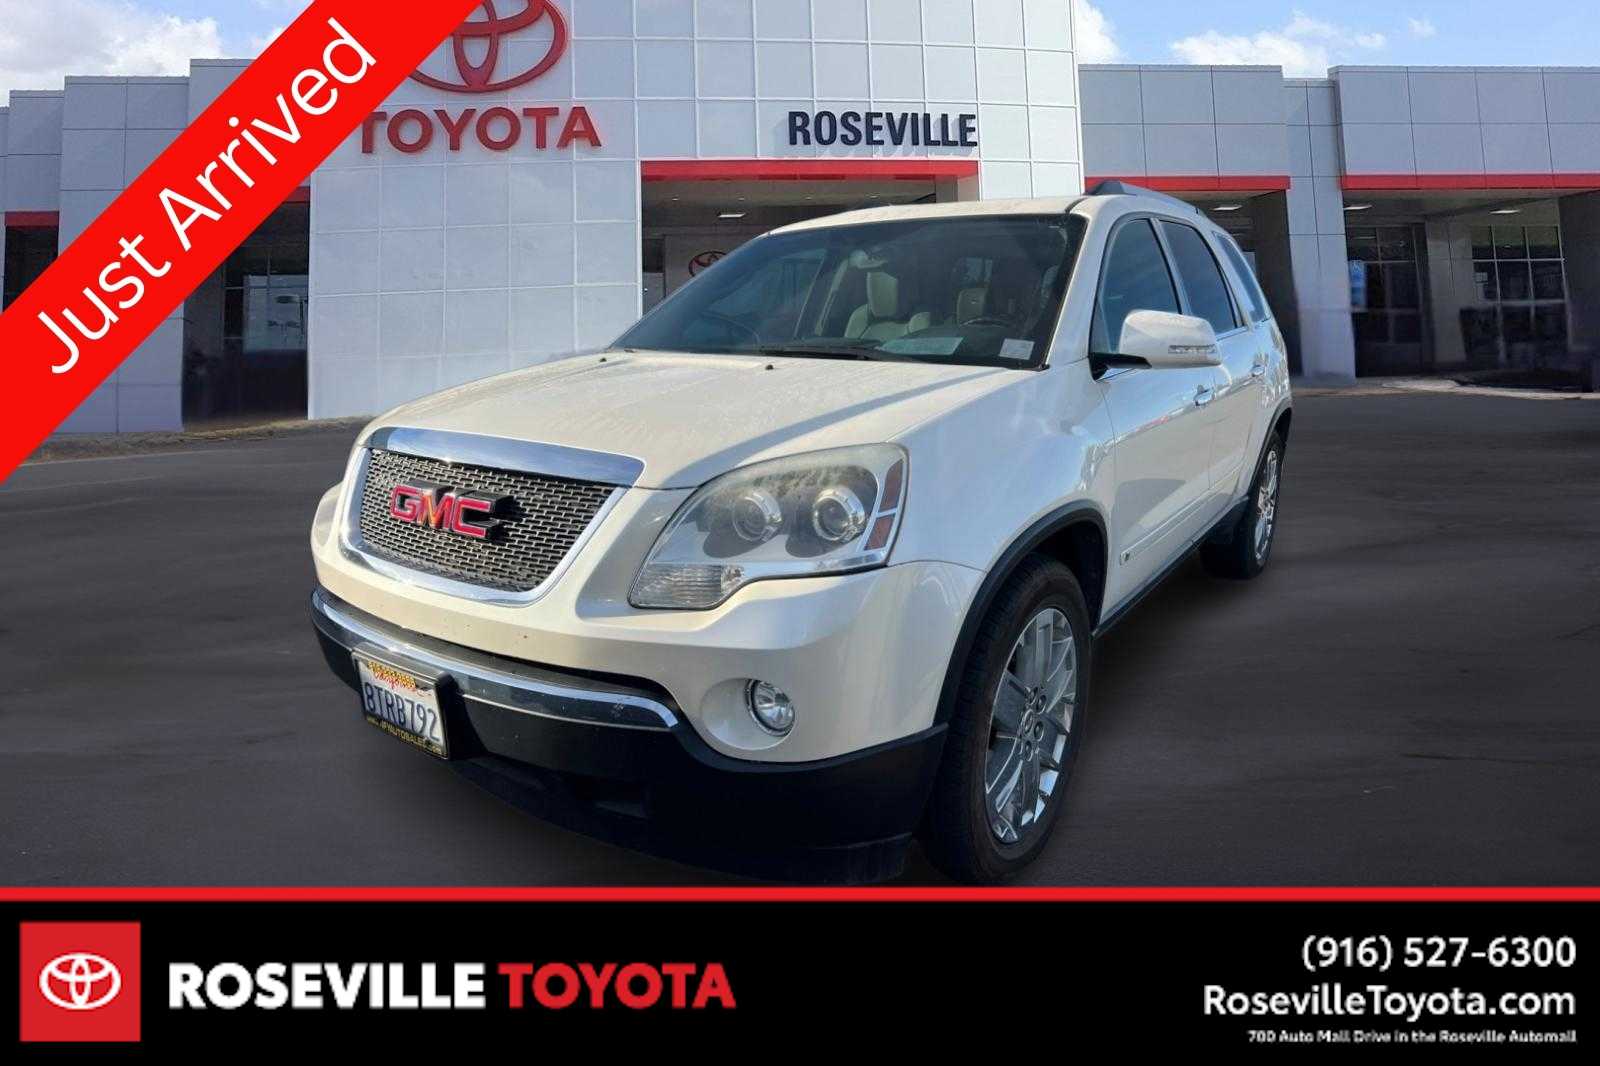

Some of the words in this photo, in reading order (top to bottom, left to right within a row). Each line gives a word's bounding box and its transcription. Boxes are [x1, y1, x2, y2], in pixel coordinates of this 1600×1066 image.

[361, 106, 601, 154] TOYOTA
[789, 111, 978, 147] ROSEVILLE
[390, 484, 491, 538] GMC
[364, 682, 440, 742] 8TRB792
